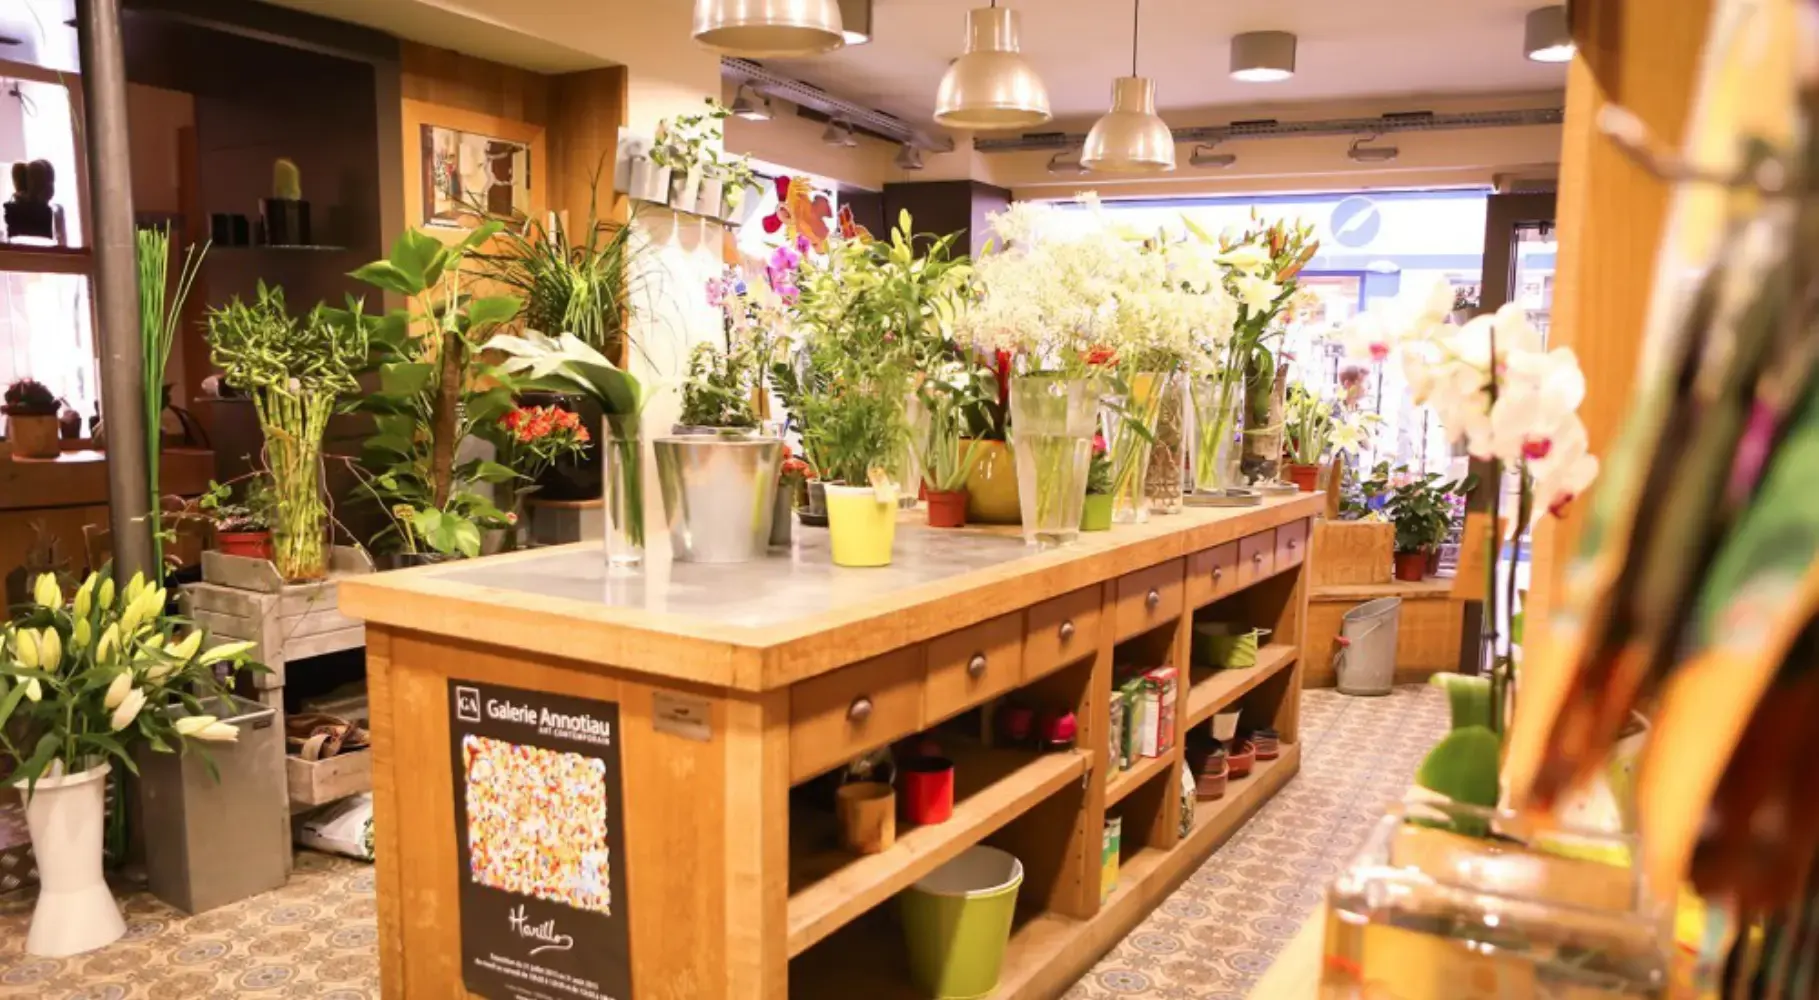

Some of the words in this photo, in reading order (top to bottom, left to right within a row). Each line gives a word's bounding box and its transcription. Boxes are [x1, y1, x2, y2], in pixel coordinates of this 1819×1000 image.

[486, 699, 537, 725] Galerie
[539, 707, 610, 737] Annotiau
[538, 726, 552, 735] ART
